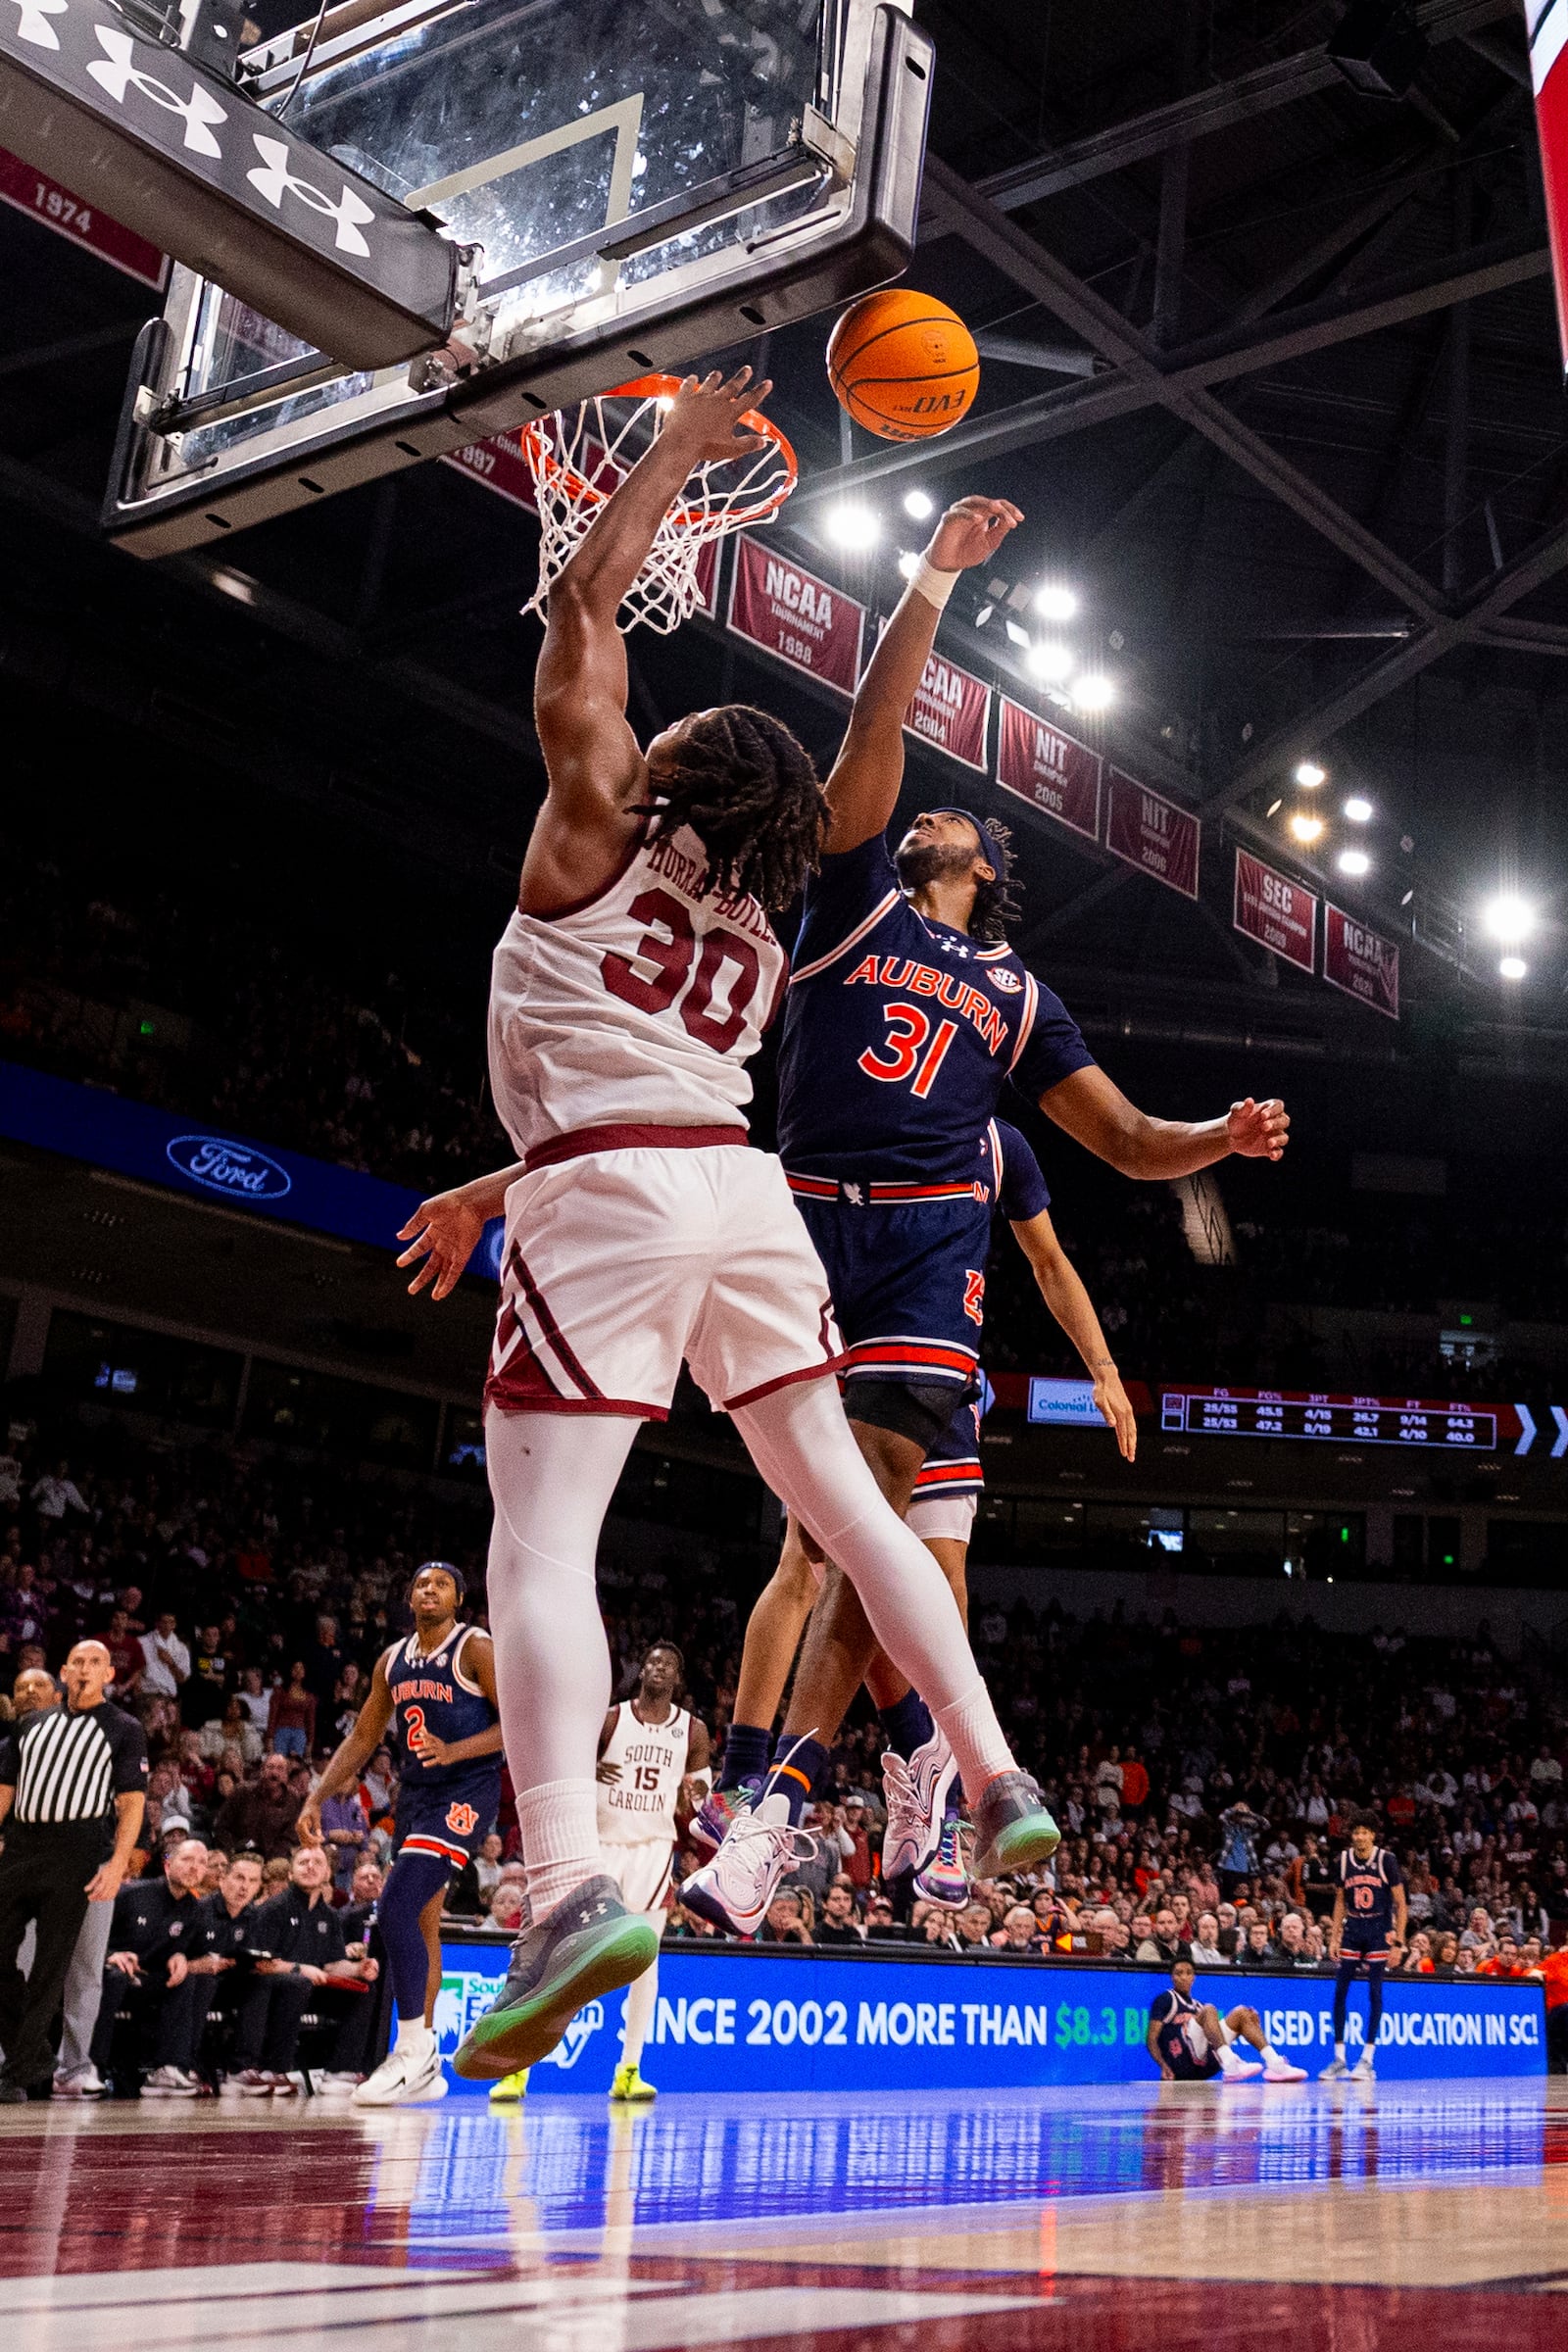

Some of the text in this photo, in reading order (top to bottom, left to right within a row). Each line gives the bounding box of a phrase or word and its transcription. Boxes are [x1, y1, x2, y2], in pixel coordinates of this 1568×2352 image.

[35, 182, 92, 233] 1974
[912, 389, 966, 413] EVO
[453, 444, 497, 474] 997
[765, 561, 832, 630] NCAA
[920, 658, 962, 710] CAA
[1035, 728, 1068, 770] NIT
[1035, 783, 1063, 811] 2005
[1142, 793, 1170, 833] NIT
[1262, 874, 1293, 914] SEC
[600, 887, 760, 1054] 30
[843, 955, 1008, 1056] AUBURN
[858, 1003, 958, 1099] 31
[190, 1143, 270, 1192] Ford
[1039, 1398, 1087, 1412] Colonial
[1304, 1409, 1332, 1420] 4/15
[1352, 1412, 1380, 1423] 26.7
[1399, 1414, 1428, 1426] 9/14
[1202, 1417, 1475, 1444] 25/53 47.2 8/19 42.1 4/10 40.0
[392, 1679, 454, 1704] UBURN
[404, 1704, 426, 1750] 2
[623, 1744, 673, 1768] SOUTH
[635, 1766, 660, 1791] 15
[609, 1787, 665, 1812] CAROLIN
[1353, 1886, 1374, 1910] 10
[468, 1978, 505, 1994] Sou
[745, 1997, 848, 2046] 2002
[856, 2001, 956, 2046] MORE
[960, 2003, 1048, 2046] THAN
[1054, 2001, 1117, 2050] $8.3
[1374, 2012, 1483, 2046] DUCATION
[1485, 2014, 1506, 2045] IN
[1509, 2013, 1540, 2046] SC!
